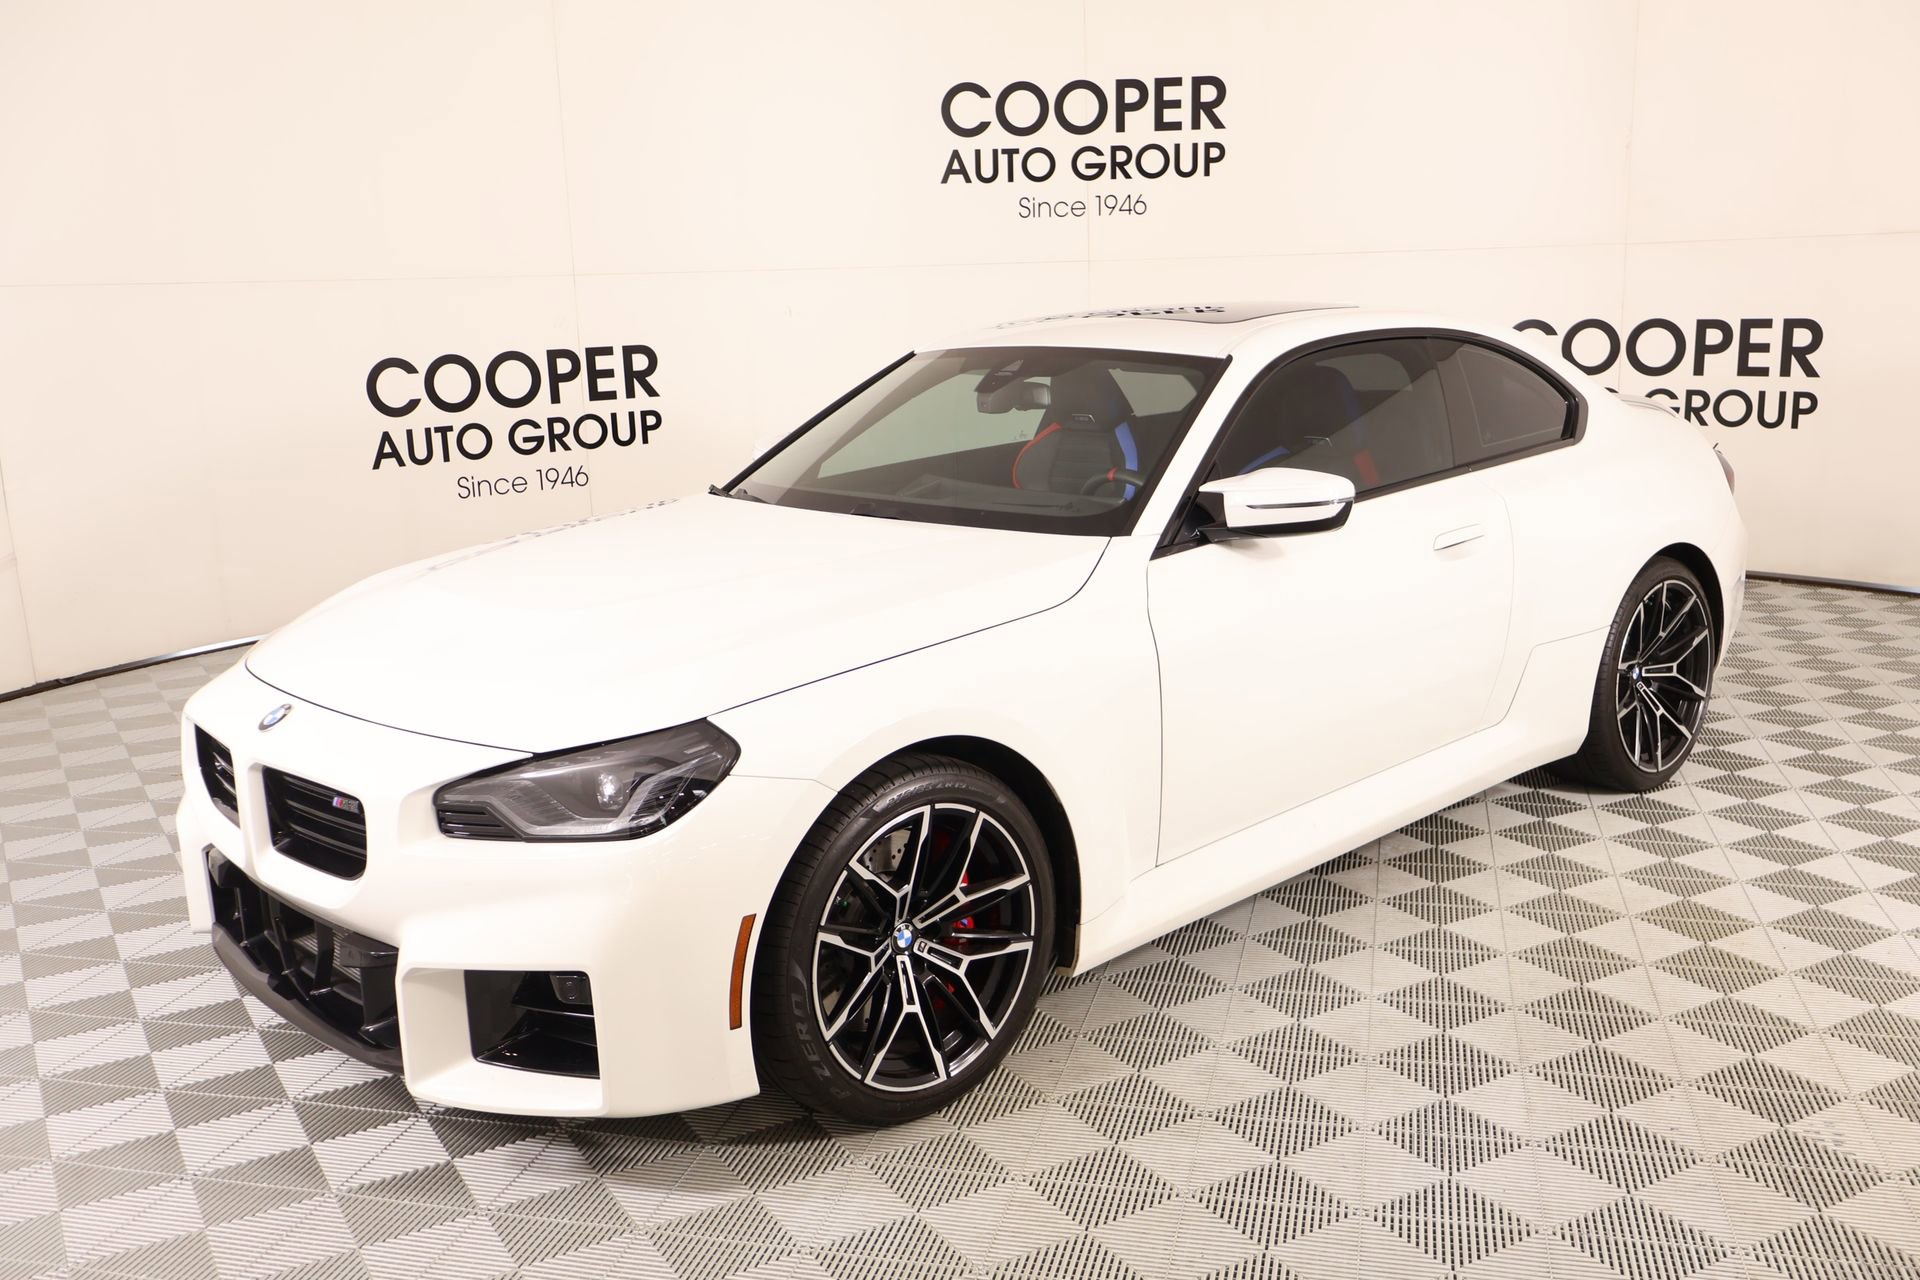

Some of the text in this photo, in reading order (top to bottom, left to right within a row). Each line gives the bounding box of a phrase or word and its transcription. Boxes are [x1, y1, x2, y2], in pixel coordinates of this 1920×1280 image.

[941, 76, 1227, 138] COOPER
[941, 142, 1226, 184] AUTO GROUP
[1018, 194, 1148, 218] Since 1946
[1513, 318, 1824, 378] OOPER
[366, 344, 661, 418] COOPER
[372, 410, 663, 470] AUTO GROUP
[457, 465, 590, 500] Since 1946
